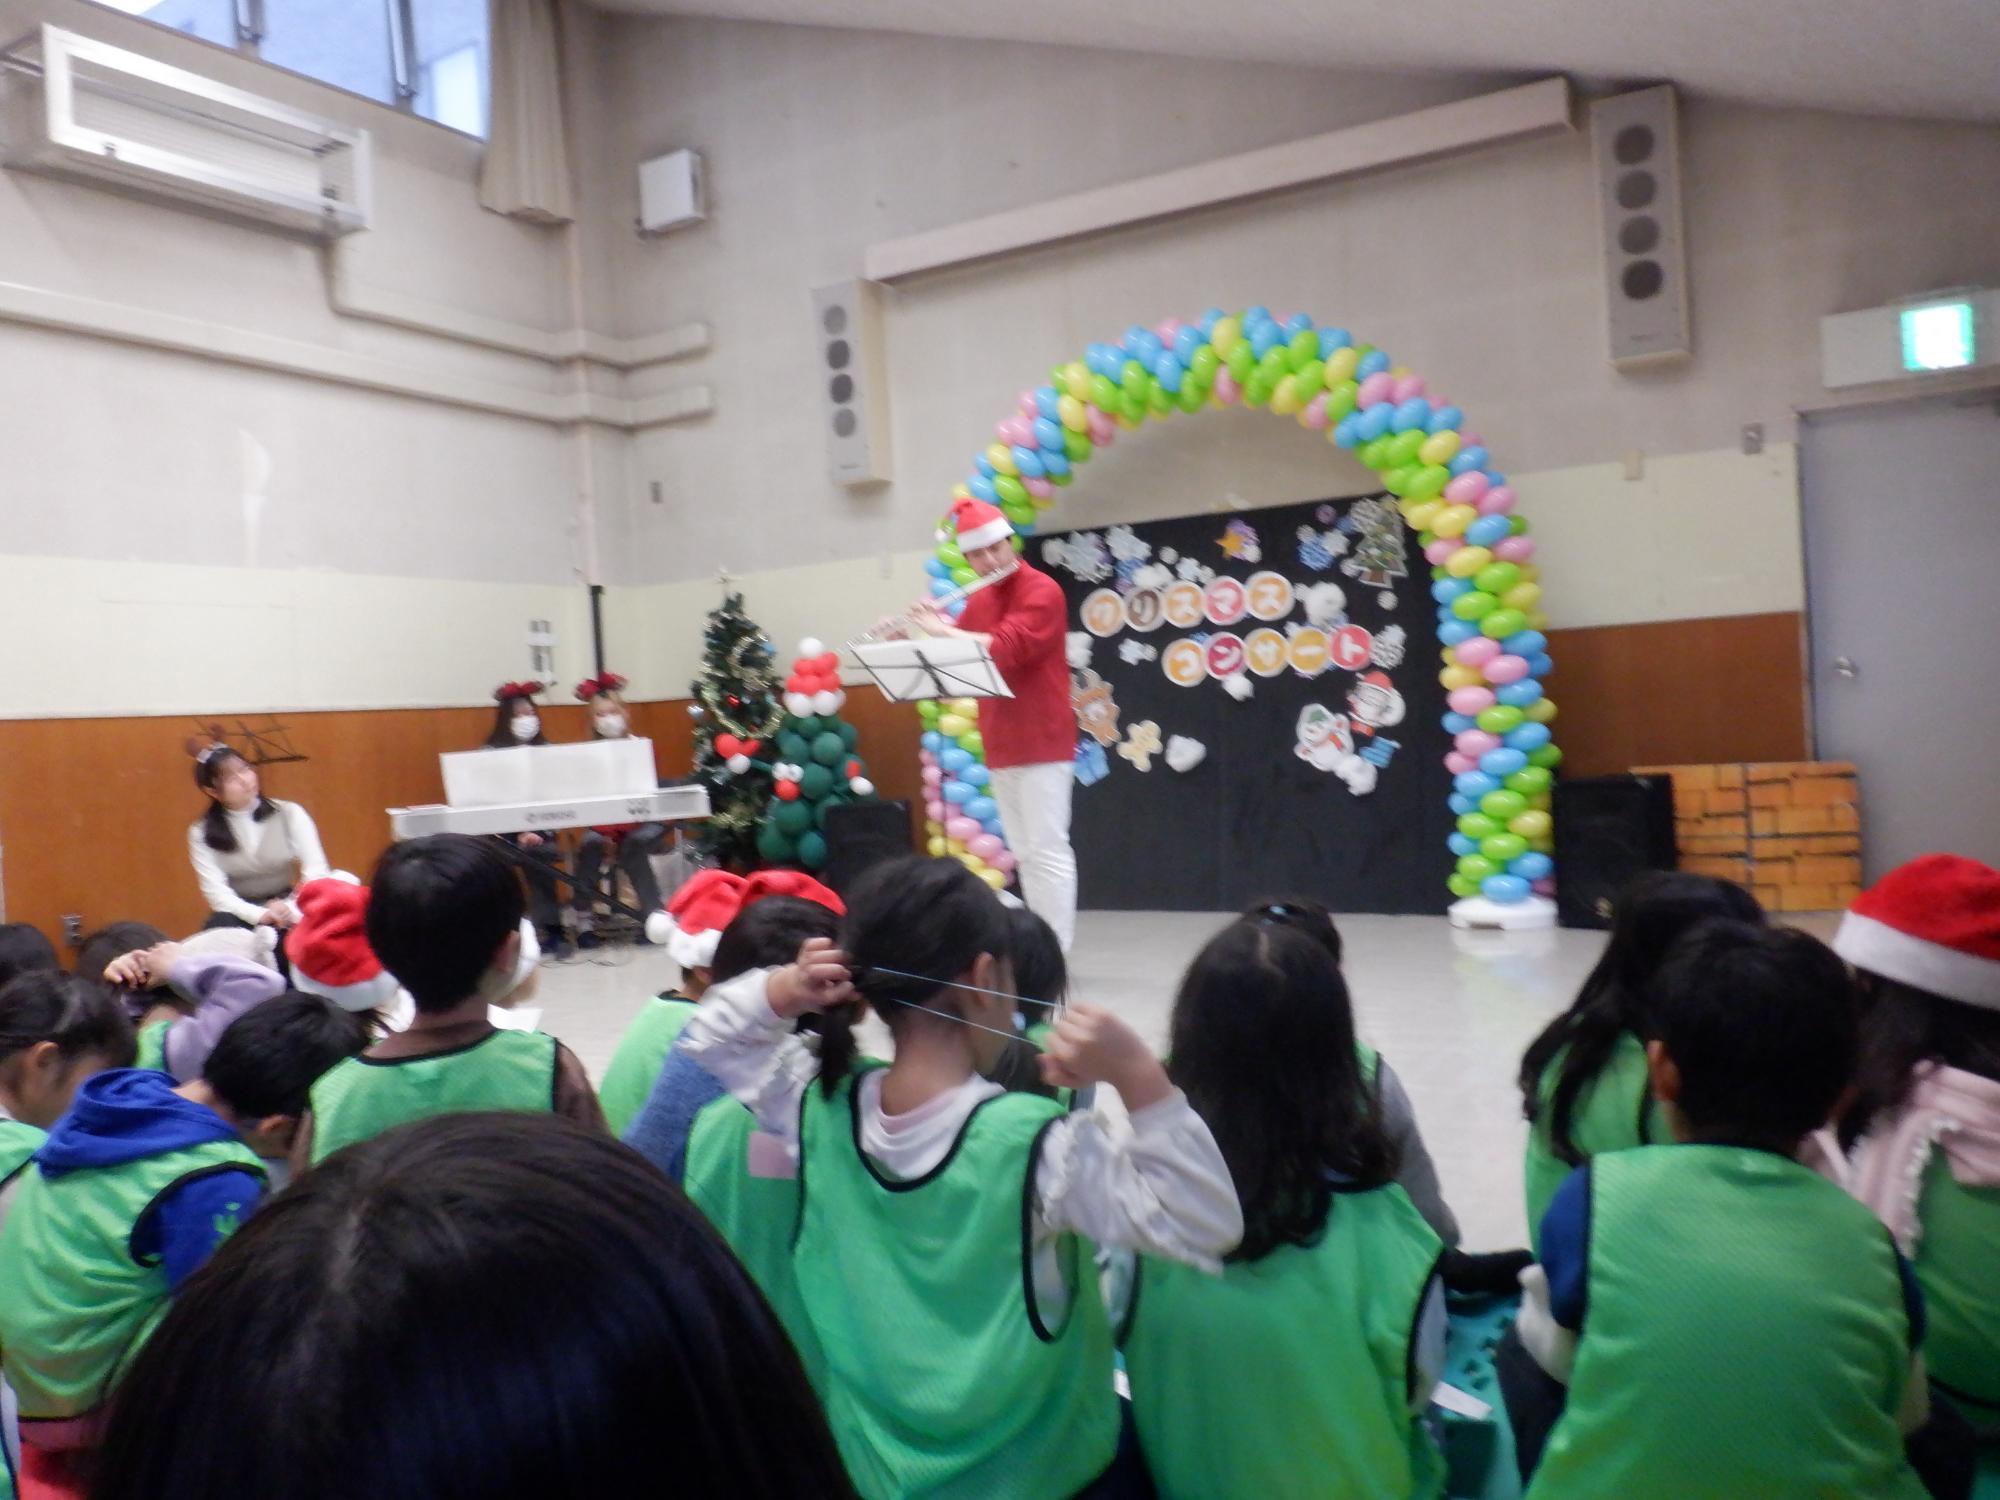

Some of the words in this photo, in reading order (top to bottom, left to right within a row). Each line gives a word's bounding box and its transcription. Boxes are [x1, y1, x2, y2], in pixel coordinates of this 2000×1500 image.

[1168, 630, 1368, 680] コンサート
